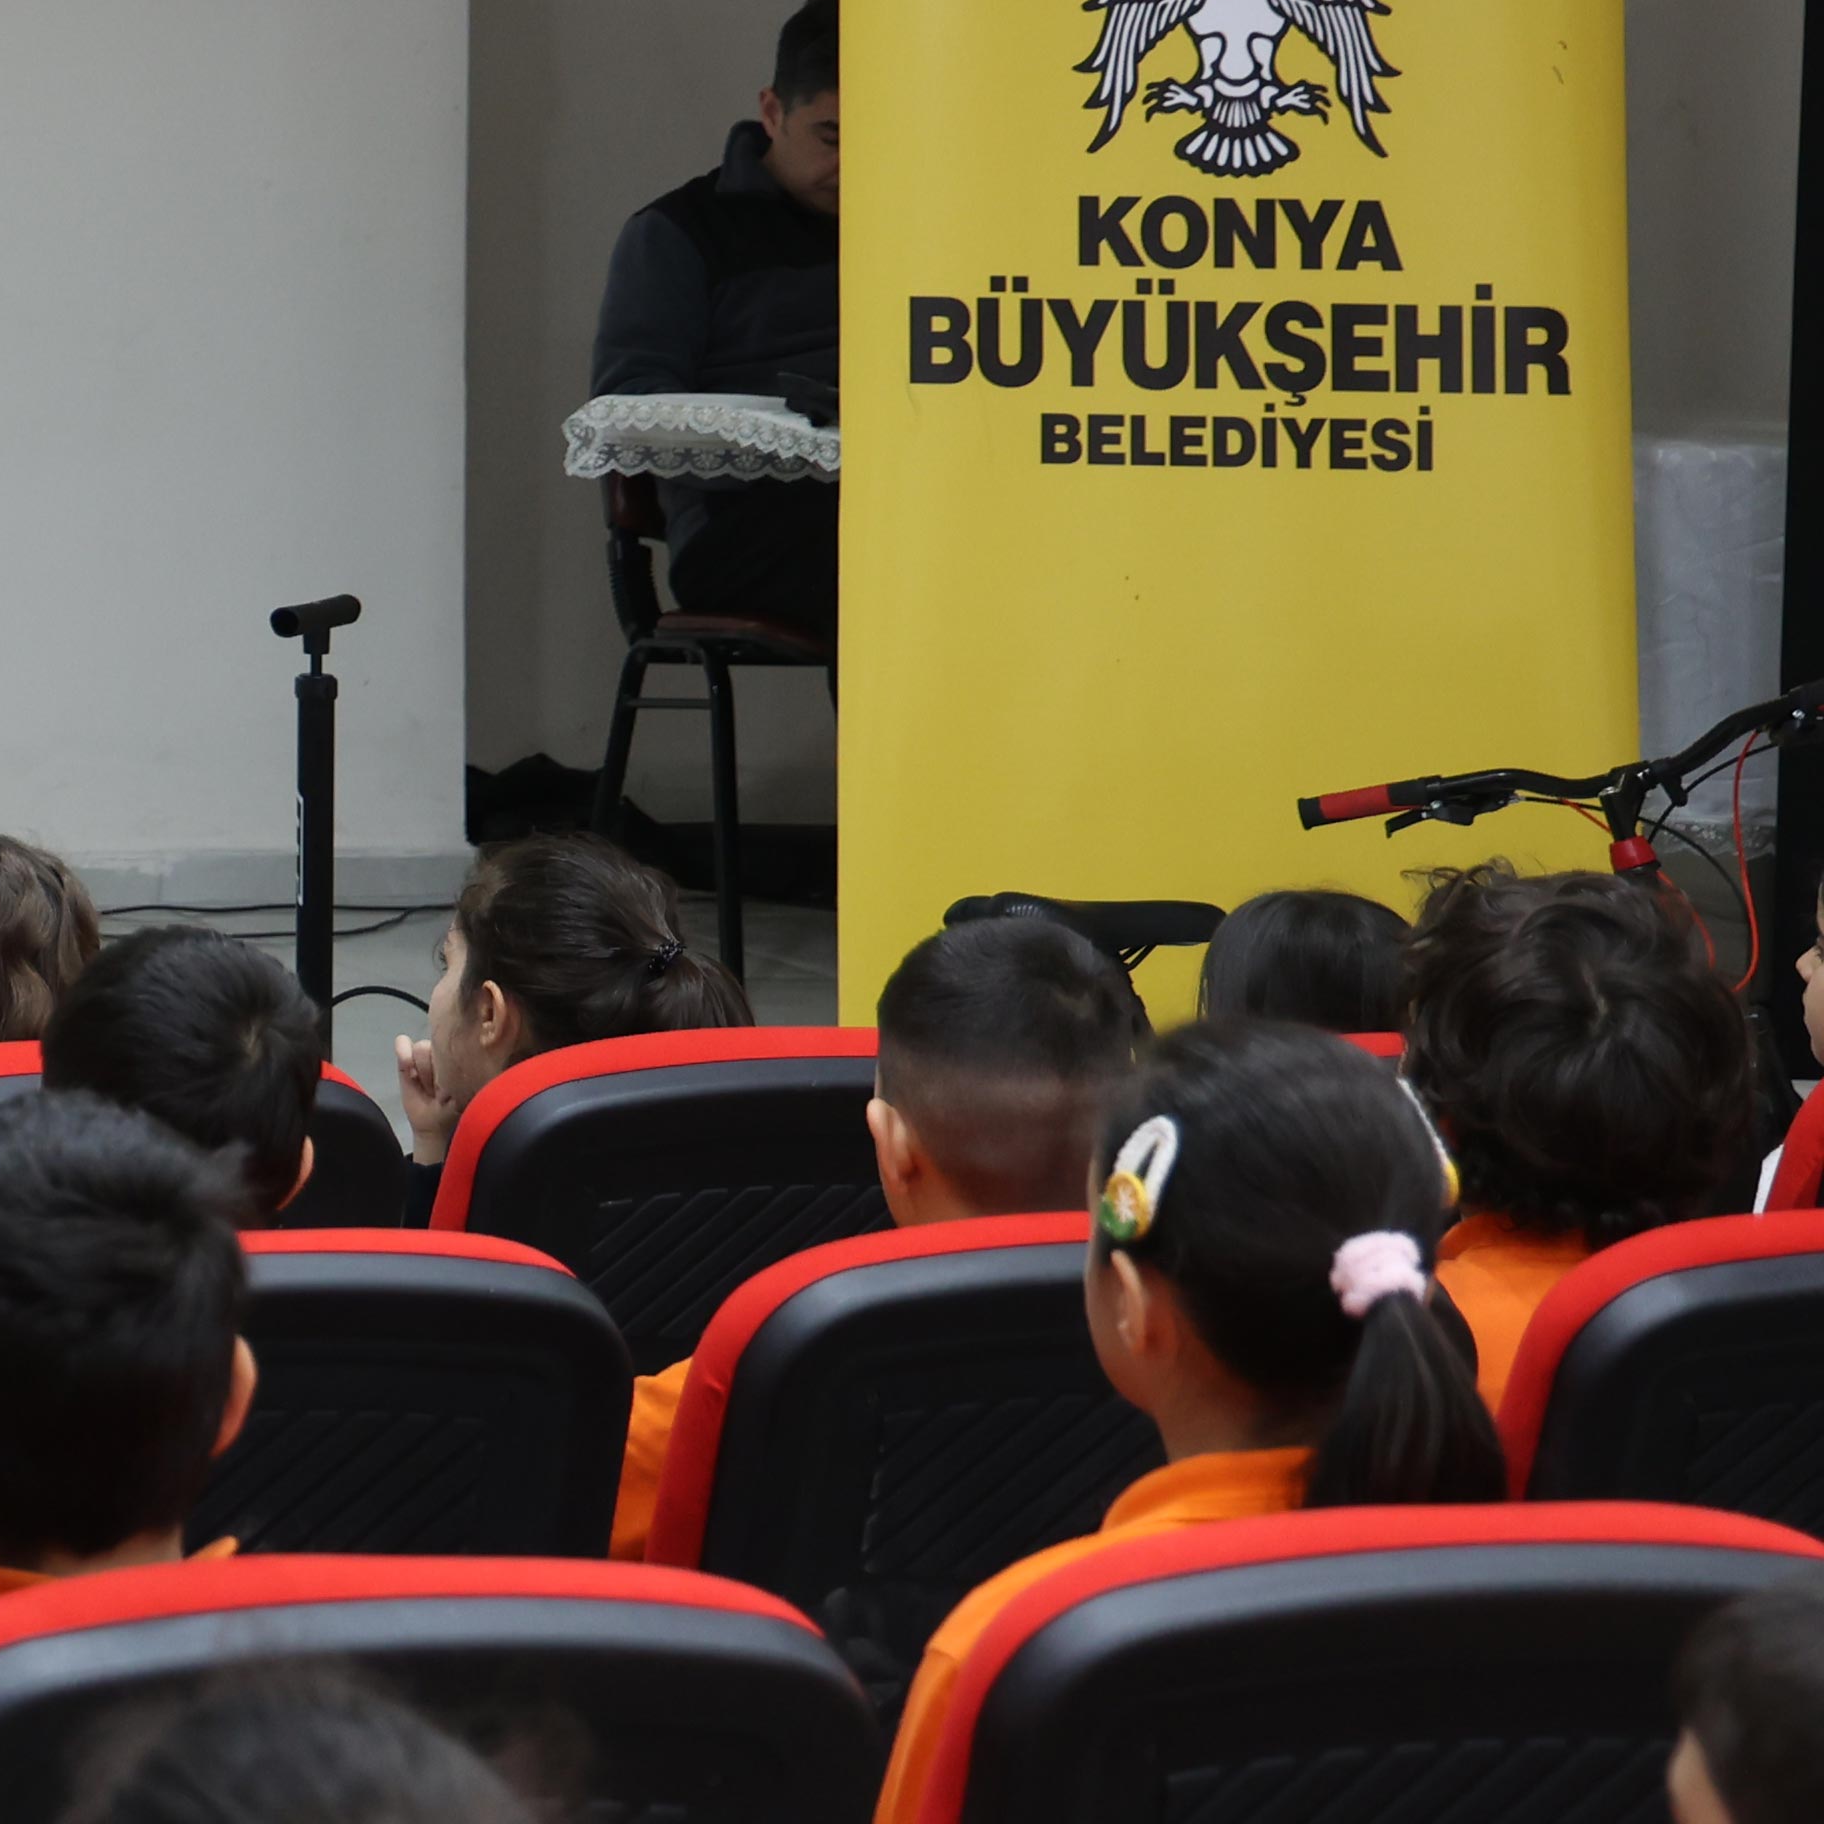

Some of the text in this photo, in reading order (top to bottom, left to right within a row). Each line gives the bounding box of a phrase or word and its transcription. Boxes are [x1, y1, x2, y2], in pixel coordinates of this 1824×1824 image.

[1078, 195, 1404, 272] KONYA
[909, 276, 1572, 407] BÜYÜKŞEHİR
[1040, 403, 1434, 472] BELEDİYESİ
